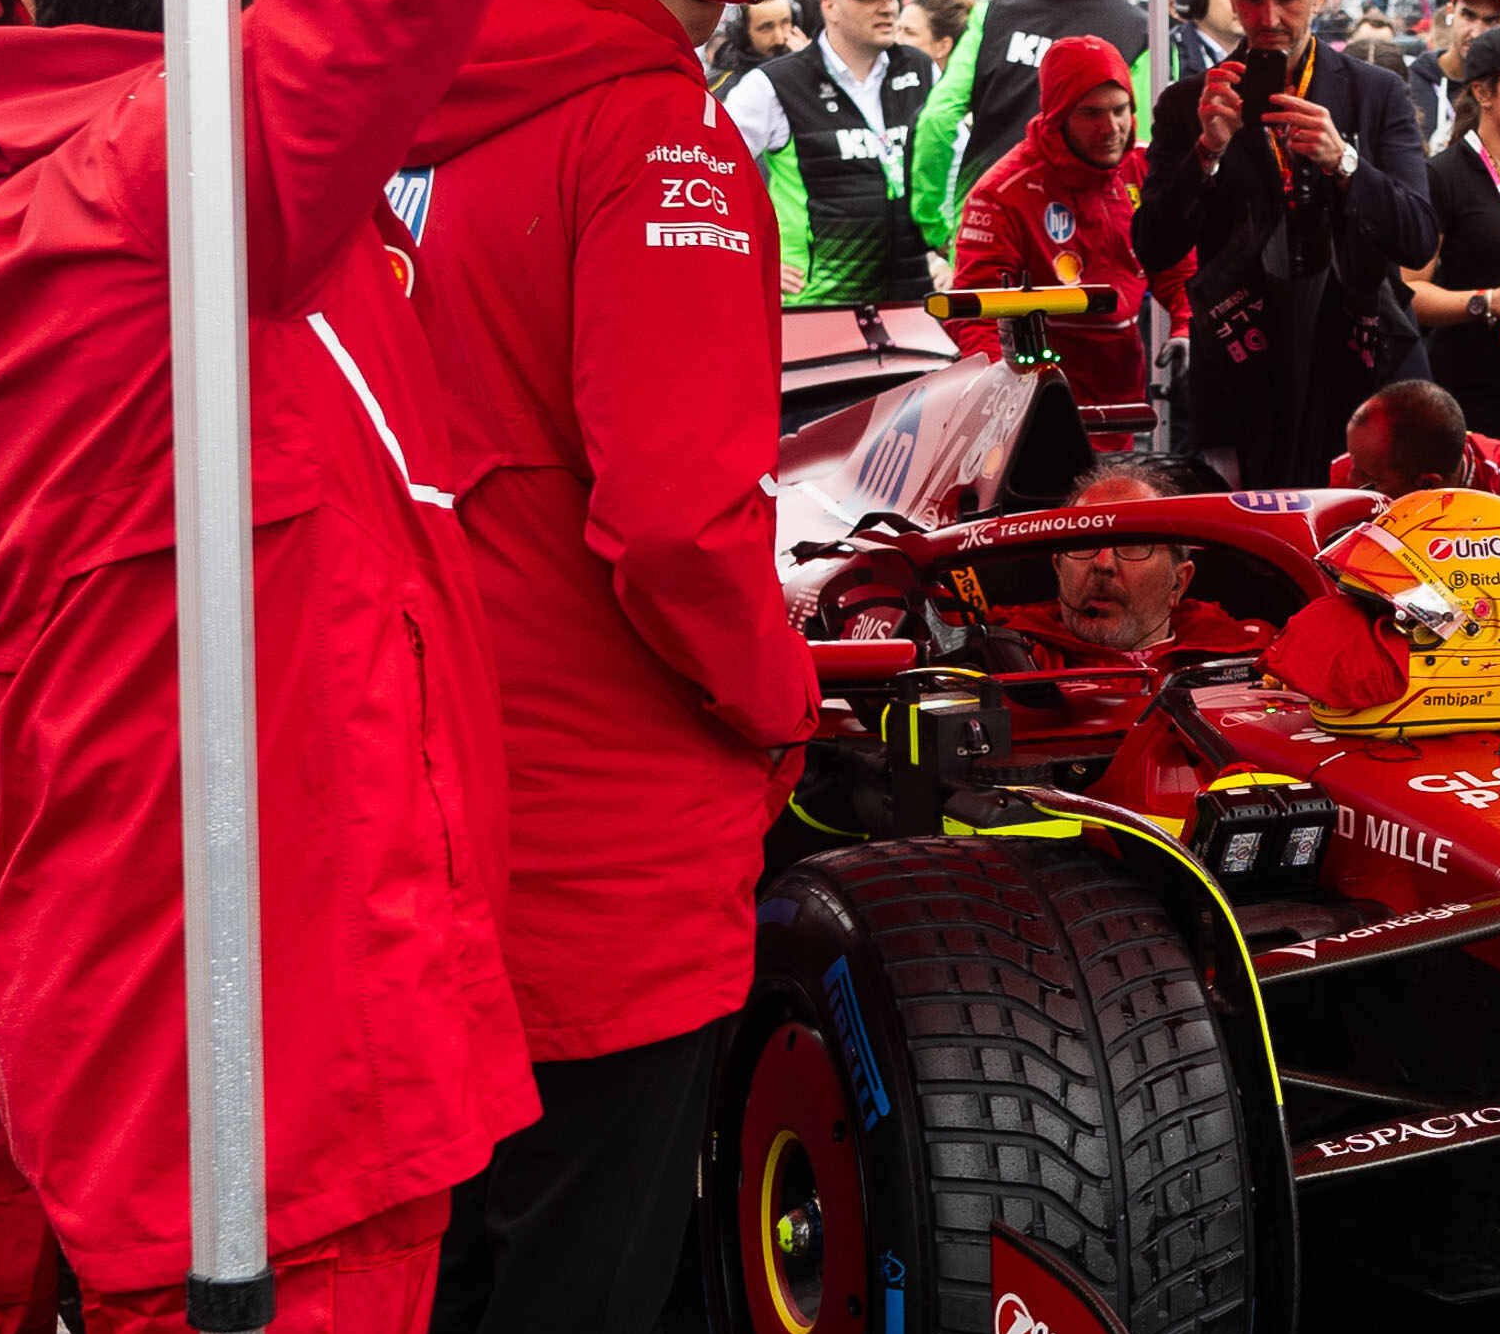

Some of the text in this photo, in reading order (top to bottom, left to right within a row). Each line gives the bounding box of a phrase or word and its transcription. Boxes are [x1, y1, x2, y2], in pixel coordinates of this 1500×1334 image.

[646, 222, 749, 255] PIRELLI
[1047, 202, 1075, 244] hp
[999, 514, 1117, 537] TECHNOLOGY
[1364, 815, 1453, 873] MILLE
[1325, 903, 1472, 944] vantage
[823, 955, 891, 1131] PIRELLI
